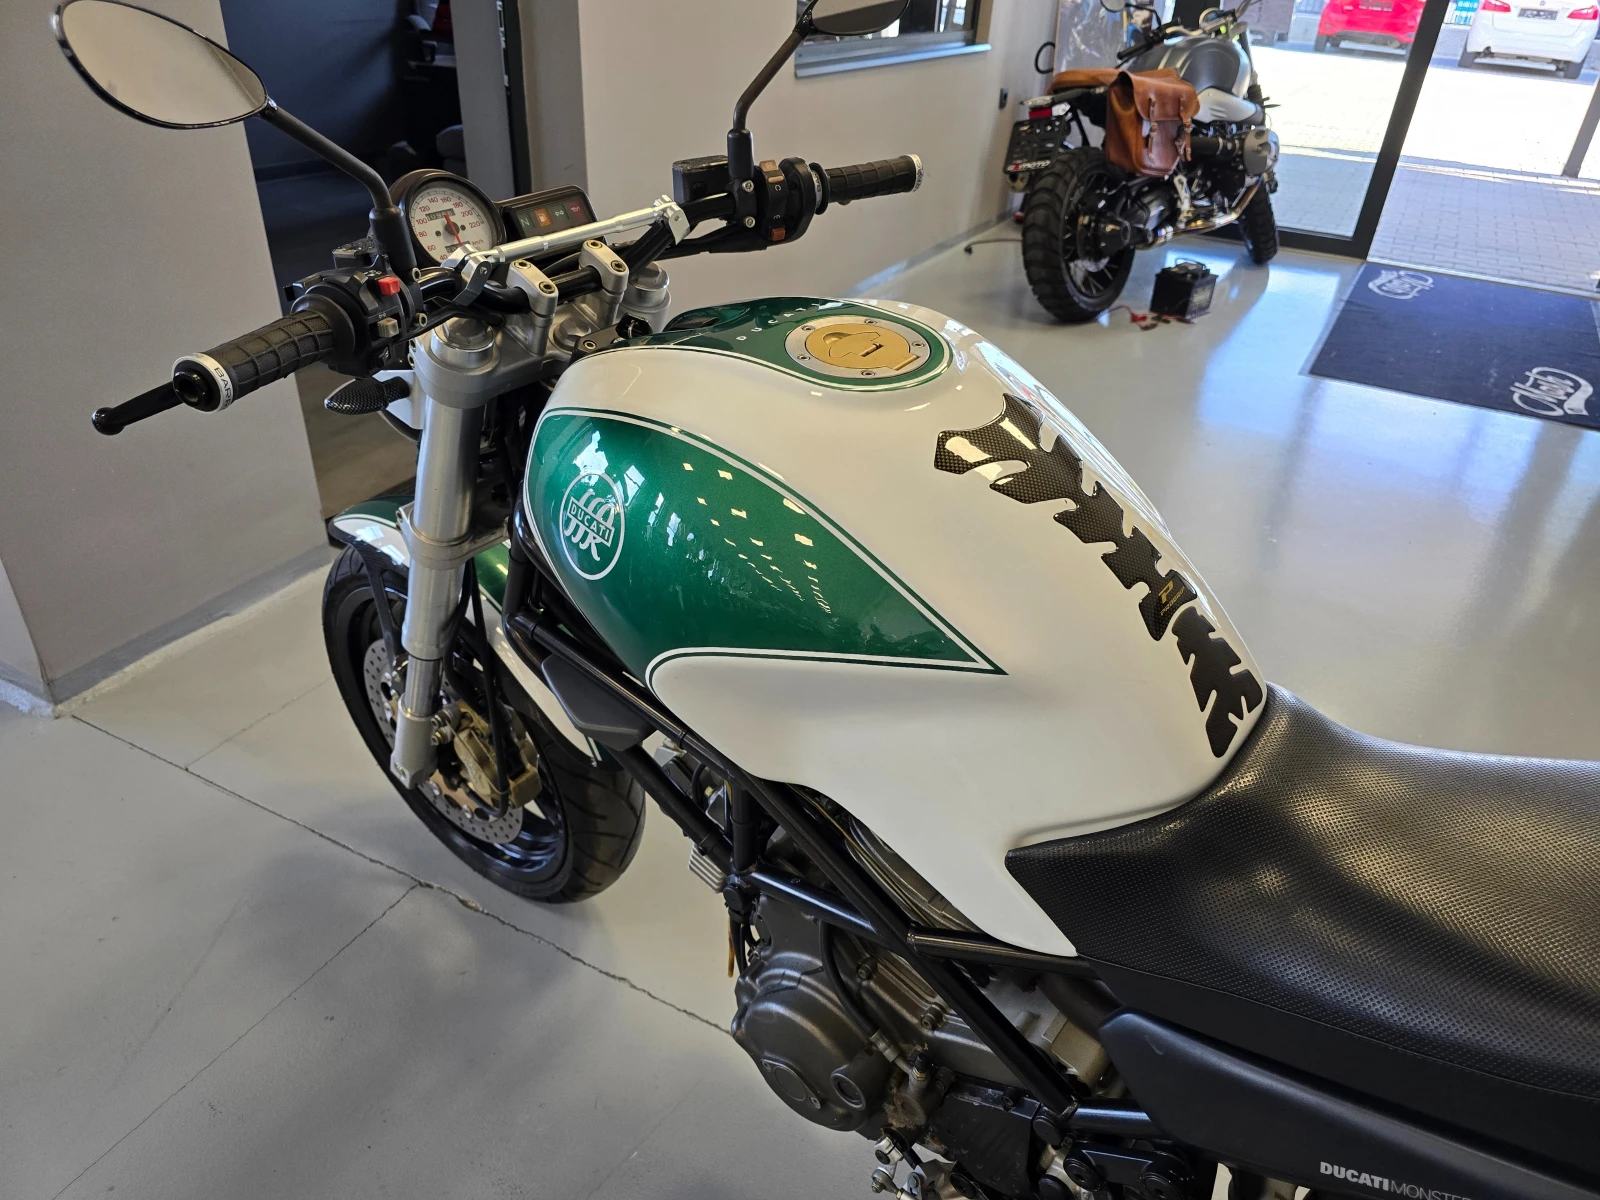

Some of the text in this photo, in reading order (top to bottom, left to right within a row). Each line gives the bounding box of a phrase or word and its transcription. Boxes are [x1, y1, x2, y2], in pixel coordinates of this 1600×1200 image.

[452, 201, 464, 209] 180
[461, 209, 473, 217] 200
[416, 217, 428, 225] 100
[469, 221, 481, 229] 220
[520, 218, 530, 227] N
[427, 244, 436, 252] 60
[570, 504, 611, 541] DUCATI
[1320, 1161, 1390, 1192] DUCATI
